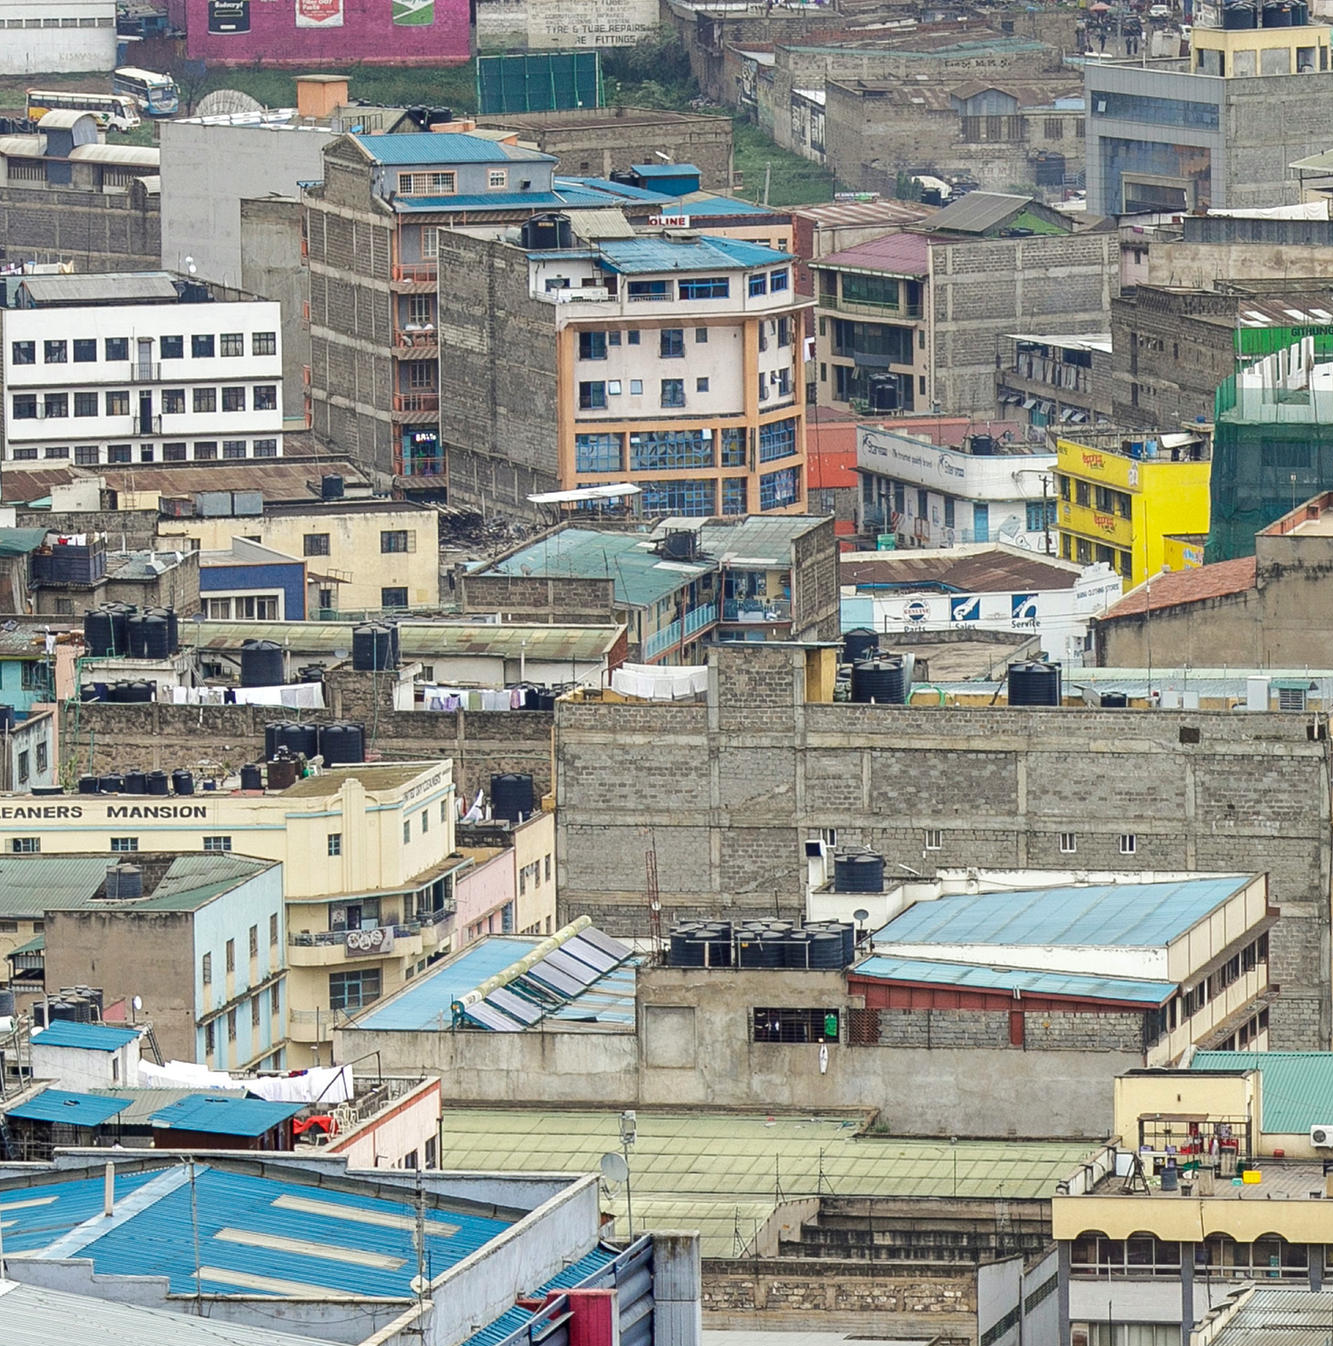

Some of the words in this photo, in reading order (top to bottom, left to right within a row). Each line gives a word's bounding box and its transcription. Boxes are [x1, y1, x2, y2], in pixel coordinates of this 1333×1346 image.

[595, 35, 636, 44] FITTINGS
[954, 622, 976, 630] Sales
[1011, 618, 1041, 630] Service
[106, 805, 208, 819] MANSION
